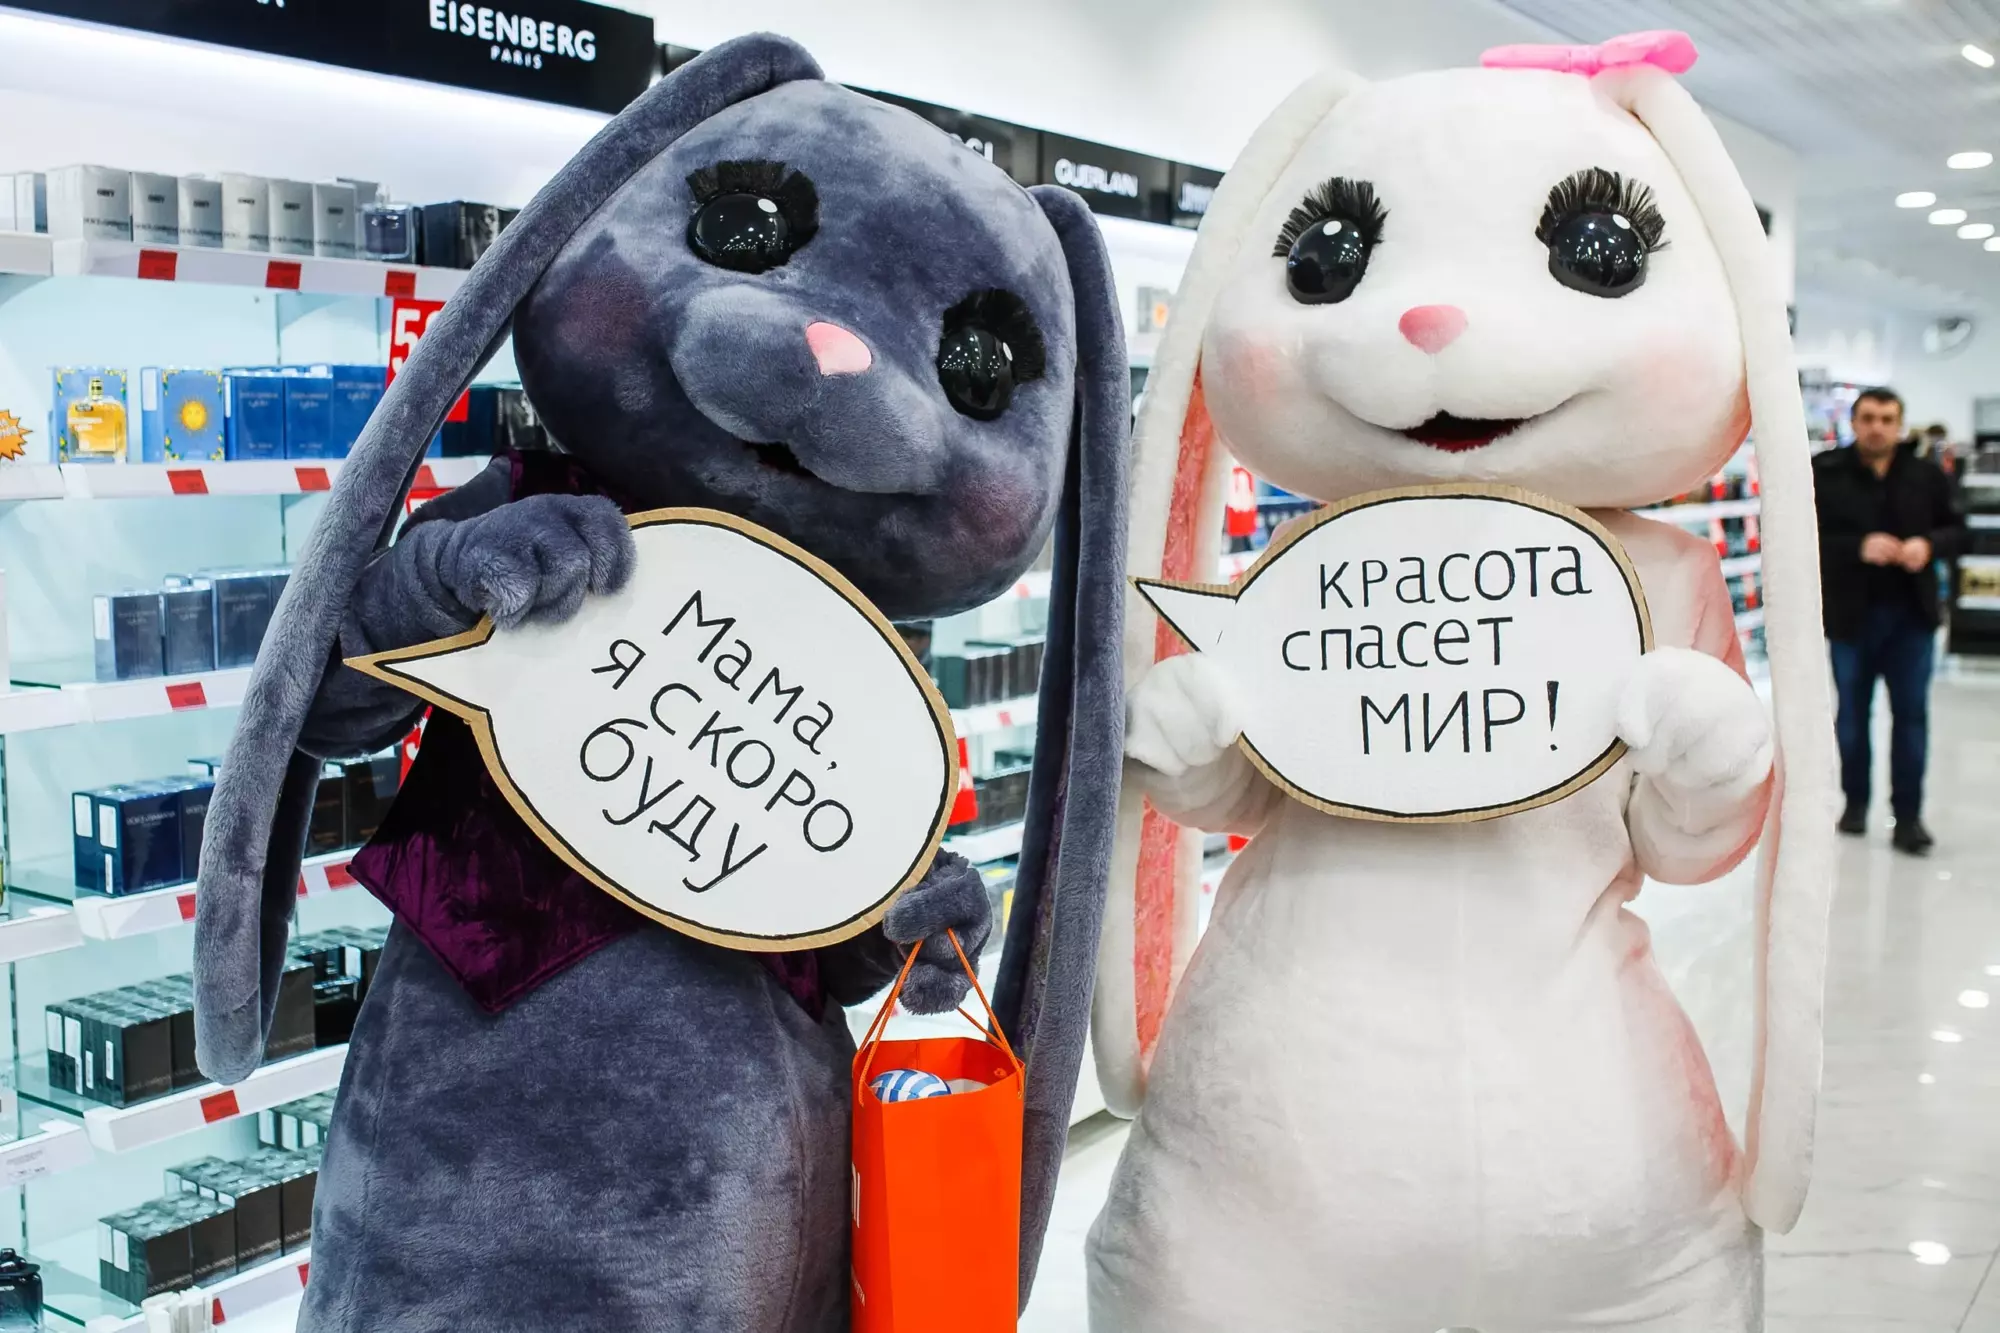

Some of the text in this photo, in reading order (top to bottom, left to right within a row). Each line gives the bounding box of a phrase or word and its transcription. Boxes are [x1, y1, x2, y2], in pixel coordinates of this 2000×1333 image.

[429, 0, 597, 62] EISENBERG
[490, 44, 544, 70] PARIS
[579, 718, 768, 894] буду
